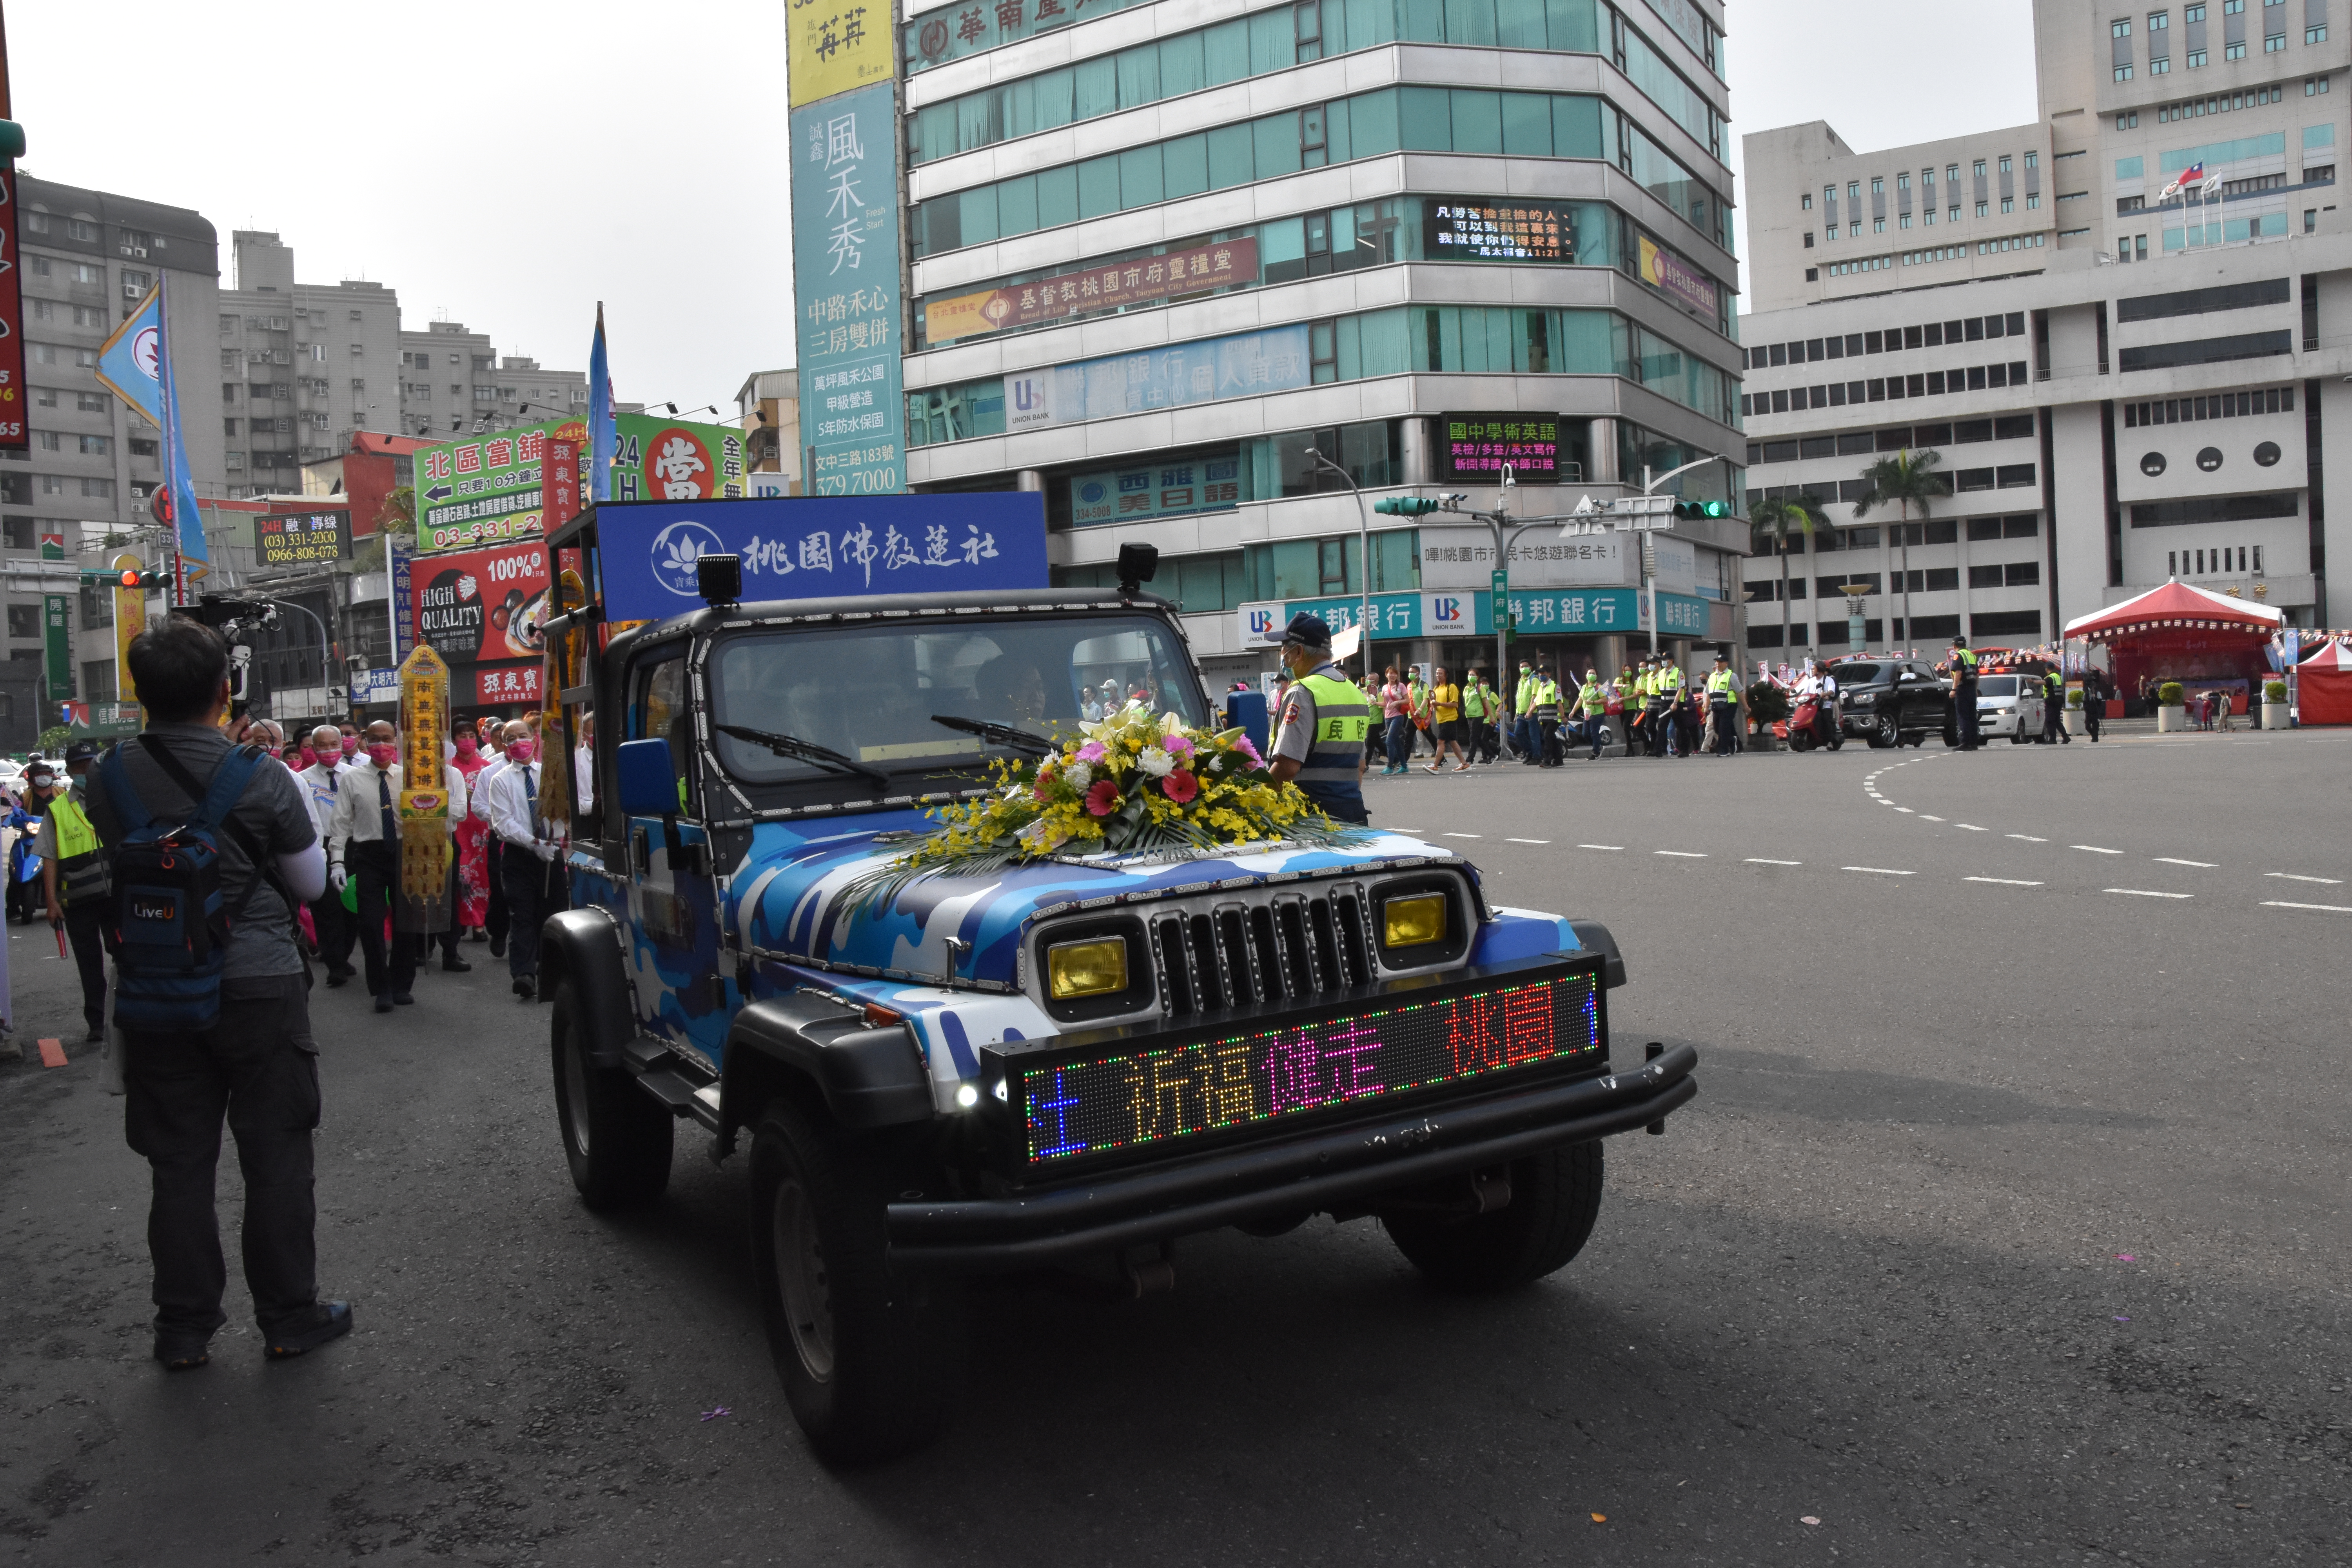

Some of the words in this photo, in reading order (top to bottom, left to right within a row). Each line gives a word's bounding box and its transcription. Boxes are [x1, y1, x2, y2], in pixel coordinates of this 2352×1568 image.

[808, 123, 824, 162] 誠鑫
[824, 113, 866, 276] 風禾秀
[866, 207, 886, 218] Fresh
[866, 219, 884, 230] Start
[1020, 249, 1232, 310] 基督教桃園市府靈糧堂
[808, 285, 888, 325] 中路禾心
[1053, 305, 1066, 314] Life
[1135, 287, 1165, 298] Taoyuan
[1168, 283, 1183, 292] City
[1187, 274, 1232, 287] Government
[809, 317, 889, 358] 三房雙併
[815, 364, 884, 392] 萬坪風禾公園
[826, 390, 873, 412] 甲級營造
[818, 412, 884, 436] 5年防水保固
[1012, 415, 1031, 424] UNION
[1032, 412, 1049, 421] BANK
[1450, 422, 1557, 441] 國中學術英語
[655, 436, 706, 499] 當
[852, 467, 896, 494] 7000
[1118, 482, 1239, 513] 美日語
[1076, 505, 1111, 520] 334-5008
[260, 520, 282, 534] 24H
[263, 534, 285, 549] (03)
[288, 530, 336, 546] 331-2000
[434, 514, 544, 546] 03-331-2
[267, 545, 338, 562] 0966-808-078
[743, 522, 999, 588] 桃園佛教蓮社
[488, 554, 532, 582] 100%
[421, 585, 454, 608] HIGH
[1495, 582, 1505, 624] 縣府路
[49, 599, 63, 626] 房屋
[422, 606, 482, 630] QUALITY
[484, 668, 537, 694] 孫東寶
[416, 681, 434, 787] 南無無量壽佛
[1327, 719, 1365, 740] 民防
